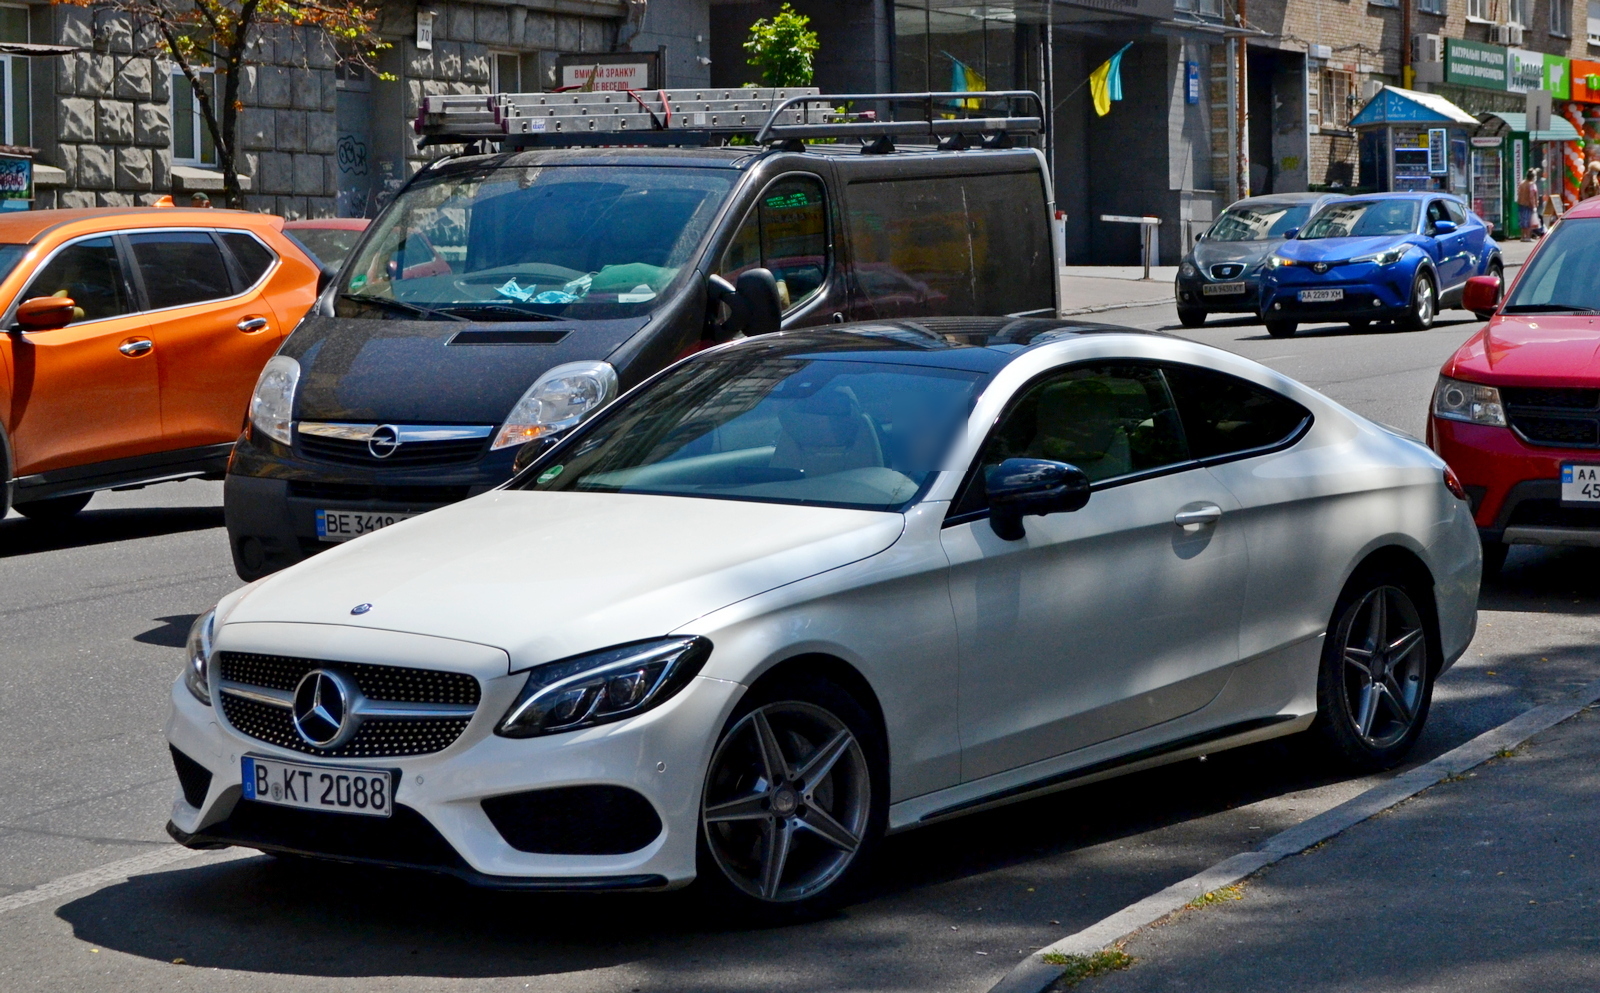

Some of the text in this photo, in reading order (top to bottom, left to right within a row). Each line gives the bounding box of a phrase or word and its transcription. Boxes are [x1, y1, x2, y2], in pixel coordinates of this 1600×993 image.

[606, 67, 636, 78] ЗРАНКУ!
[582, 82, 600, 91] ДЕ
[1313, 291, 1330, 299] 2289
[1330, 290, 1342, 298] XM
[1578, 469, 1597, 480] AA
[326, 514, 351, 533] BE
[255, 764, 386, 810] B KT 2088
